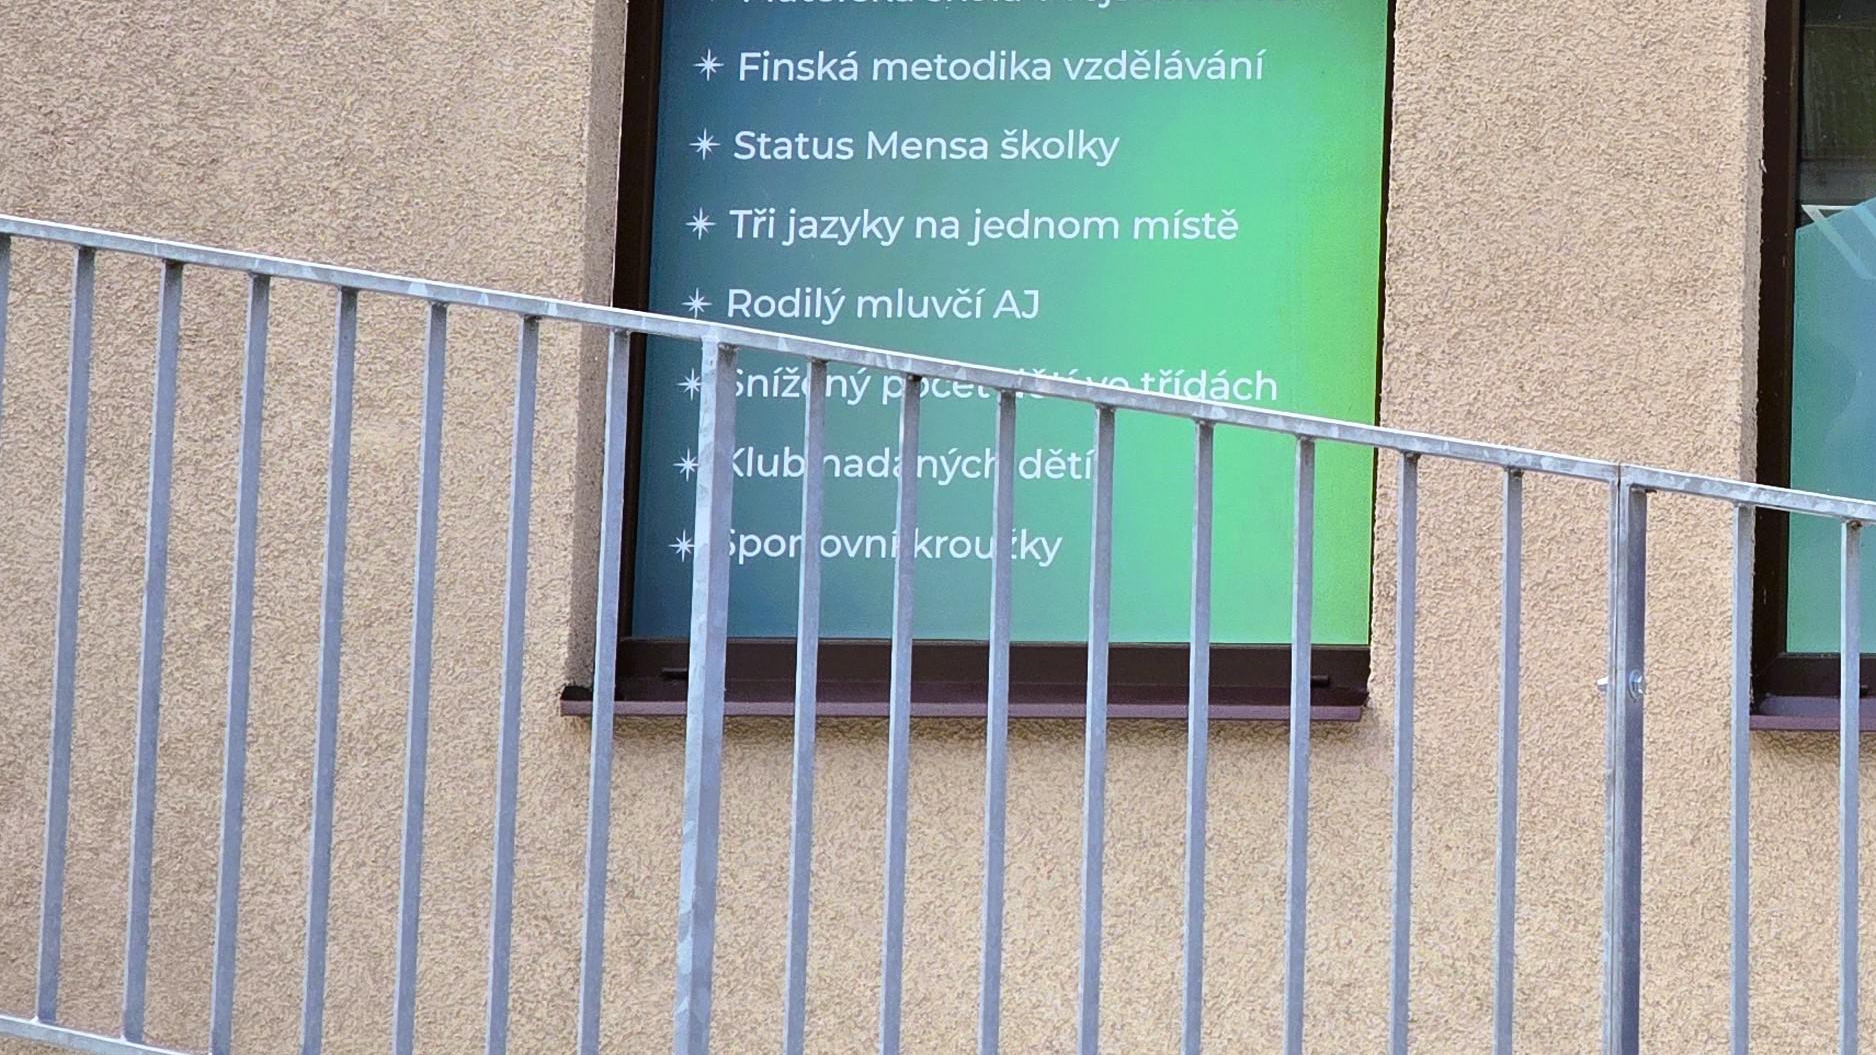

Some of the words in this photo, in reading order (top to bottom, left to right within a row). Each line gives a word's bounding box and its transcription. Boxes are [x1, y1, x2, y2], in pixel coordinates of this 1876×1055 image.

[739, 49, 859, 82] Finská
[872, 49, 1052, 81] metodika
[1063, 48, 1266, 81] vzdělávání
[733, 130, 854, 161] Status
[867, 130, 989, 160] Mensa
[1000, 128, 1120, 167] školky
[728, 207, 776, 239] Tři
[781, 207, 905, 247] jazyky
[915, 216, 960, 240] na
[967, 208, 1120, 247] jednom
[1133, 208, 1239, 240] místě
[726, 287, 846, 326] Rodilý
[856, 287, 986, 319] mluvčí
[992, 289, 1039, 319] AJ
[1140, 369, 1278, 402] třídách
[1017, 448, 1098, 480] dětí
[718, 528, 901, 565] porovní
